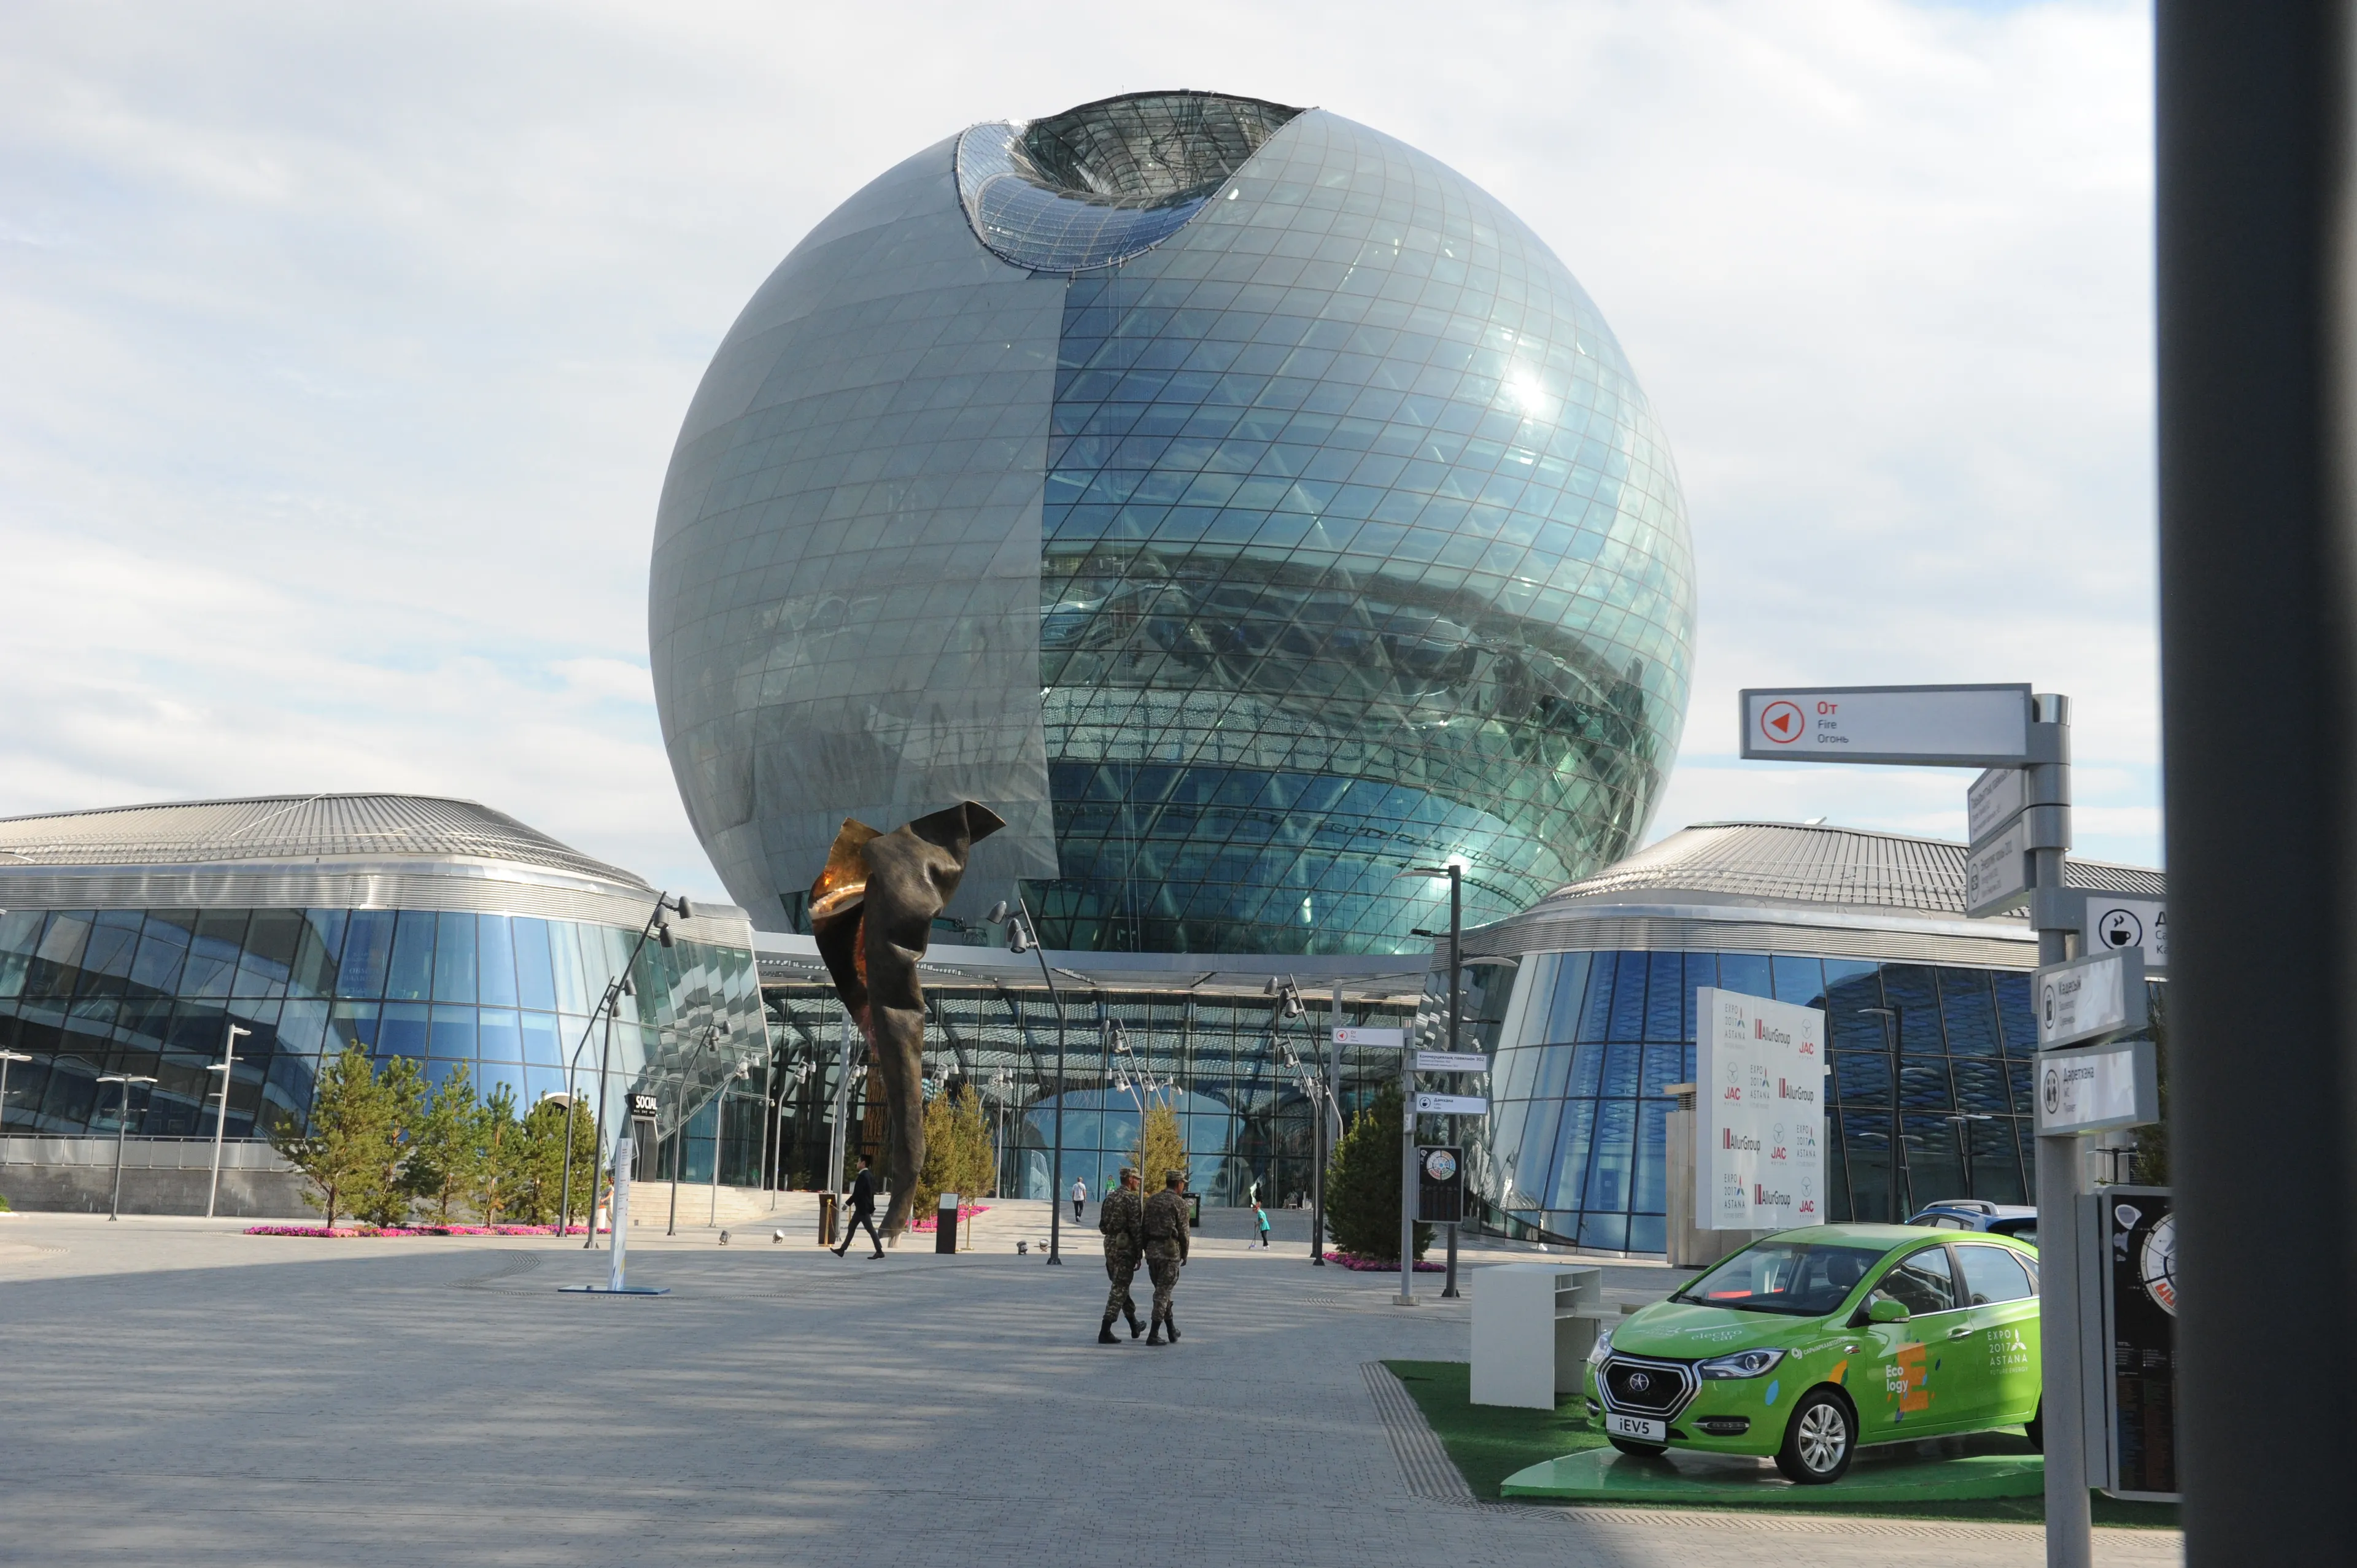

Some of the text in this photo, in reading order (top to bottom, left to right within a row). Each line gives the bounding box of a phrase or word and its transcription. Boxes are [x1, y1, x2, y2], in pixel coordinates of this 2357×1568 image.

[1817, 701, 1838, 715] От
[1818, 719, 1837, 729] Fire
[1817, 733, 1849, 743] Огонь
[2155, 930, 2168, 940] Ca
[2156, 944, 2169, 955] Ка
[1725, 1003, 1738, 1014] EXPO
[1725, 1016, 1737, 1027] 2017
[1724, 1029, 1746, 1040] ASTANA
[1799, 1041, 1814, 1055] JAC
[1751, 1064, 1763, 1075] EXPO
[1751, 1077, 1762, 1086] 2017
[1724, 1086, 1741, 1100] JAC
[1751, 1090, 1770, 1100] ASTANA
[636, 1095, 658, 1110] SOCIAL
[1797, 1124, 1809, 1134] EXPO
[1797, 1137, 1808, 1146] 2017
[1771, 1146, 1787, 1159] JAC
[1797, 1149, 1816, 1158] ASTANA
[1724, 1173, 1738, 1183] EXPO
[1724, 1186, 1736, 1196] 2017
[1724, 1200, 1746, 1209] ASTANA
[1799, 1200, 1814, 1213] JAC
[1691, 1330, 1742, 1340] electro
[1987, 1329, 2011, 1340] EXPO
[1989, 1342, 2011, 1353] 2017
[1990, 1353, 2028, 1366] ASTANA
[1886, 1364, 1904, 1378] Eco
[1886, 1378, 1909, 1394] logy
[1620, 1418, 1649, 1434] iEV5
